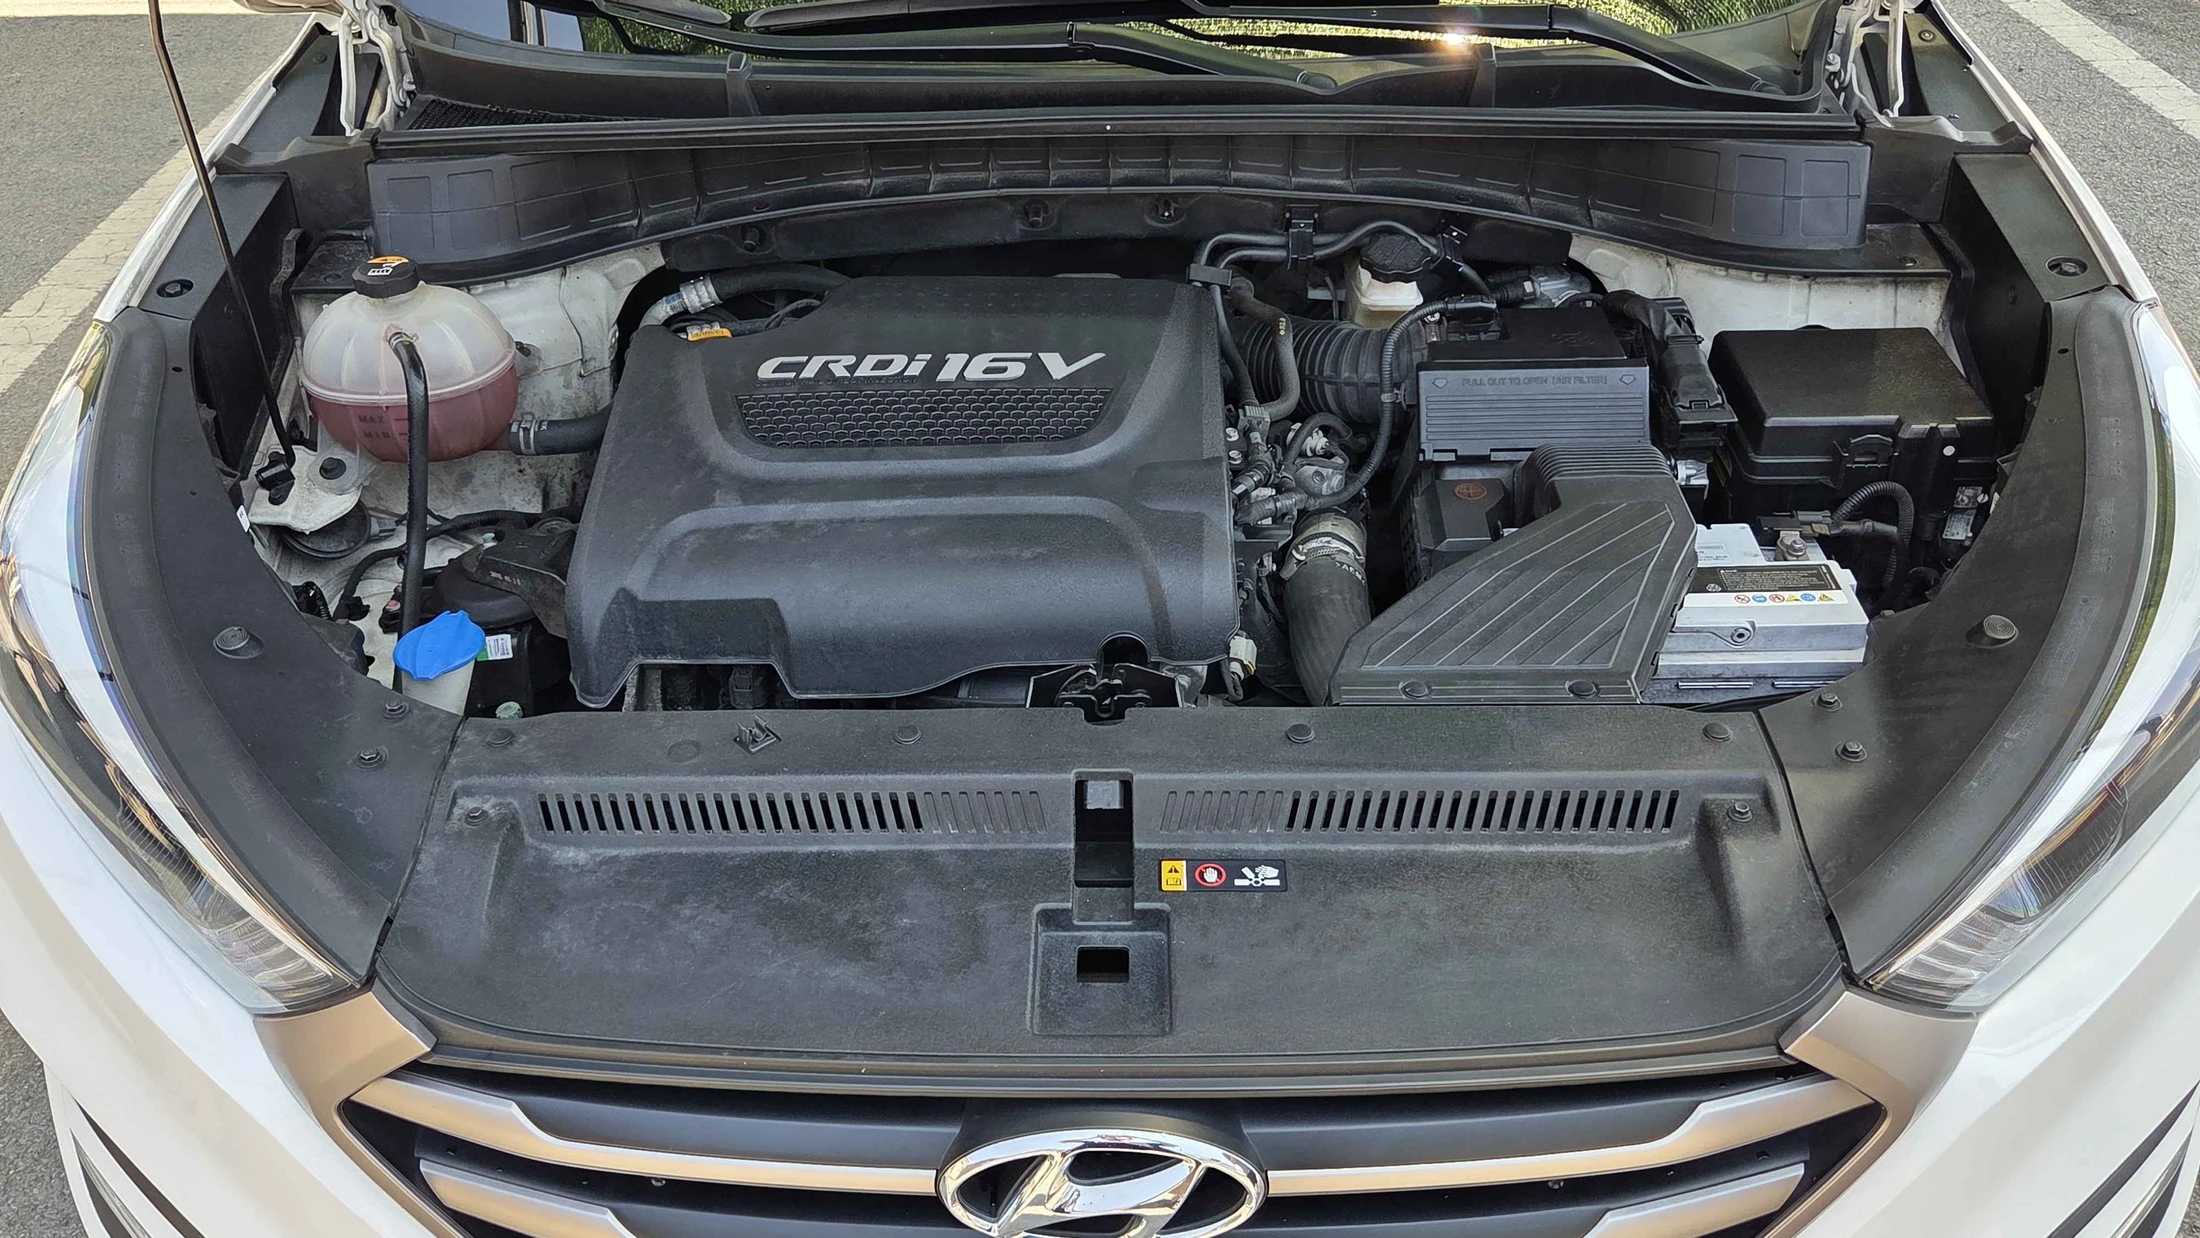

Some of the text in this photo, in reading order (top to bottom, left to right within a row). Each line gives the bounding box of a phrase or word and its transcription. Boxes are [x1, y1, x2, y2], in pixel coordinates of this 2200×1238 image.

[757, 352, 1106, 382] CRDi 16V
[1461, 377, 1486, 387] PULL
[1487, 377, 1507, 386] OUT
[1508, 377, 1521, 386] TO
[1522, 376, 1549, 386] OPEN
[358, 415, 385, 424] MAX
